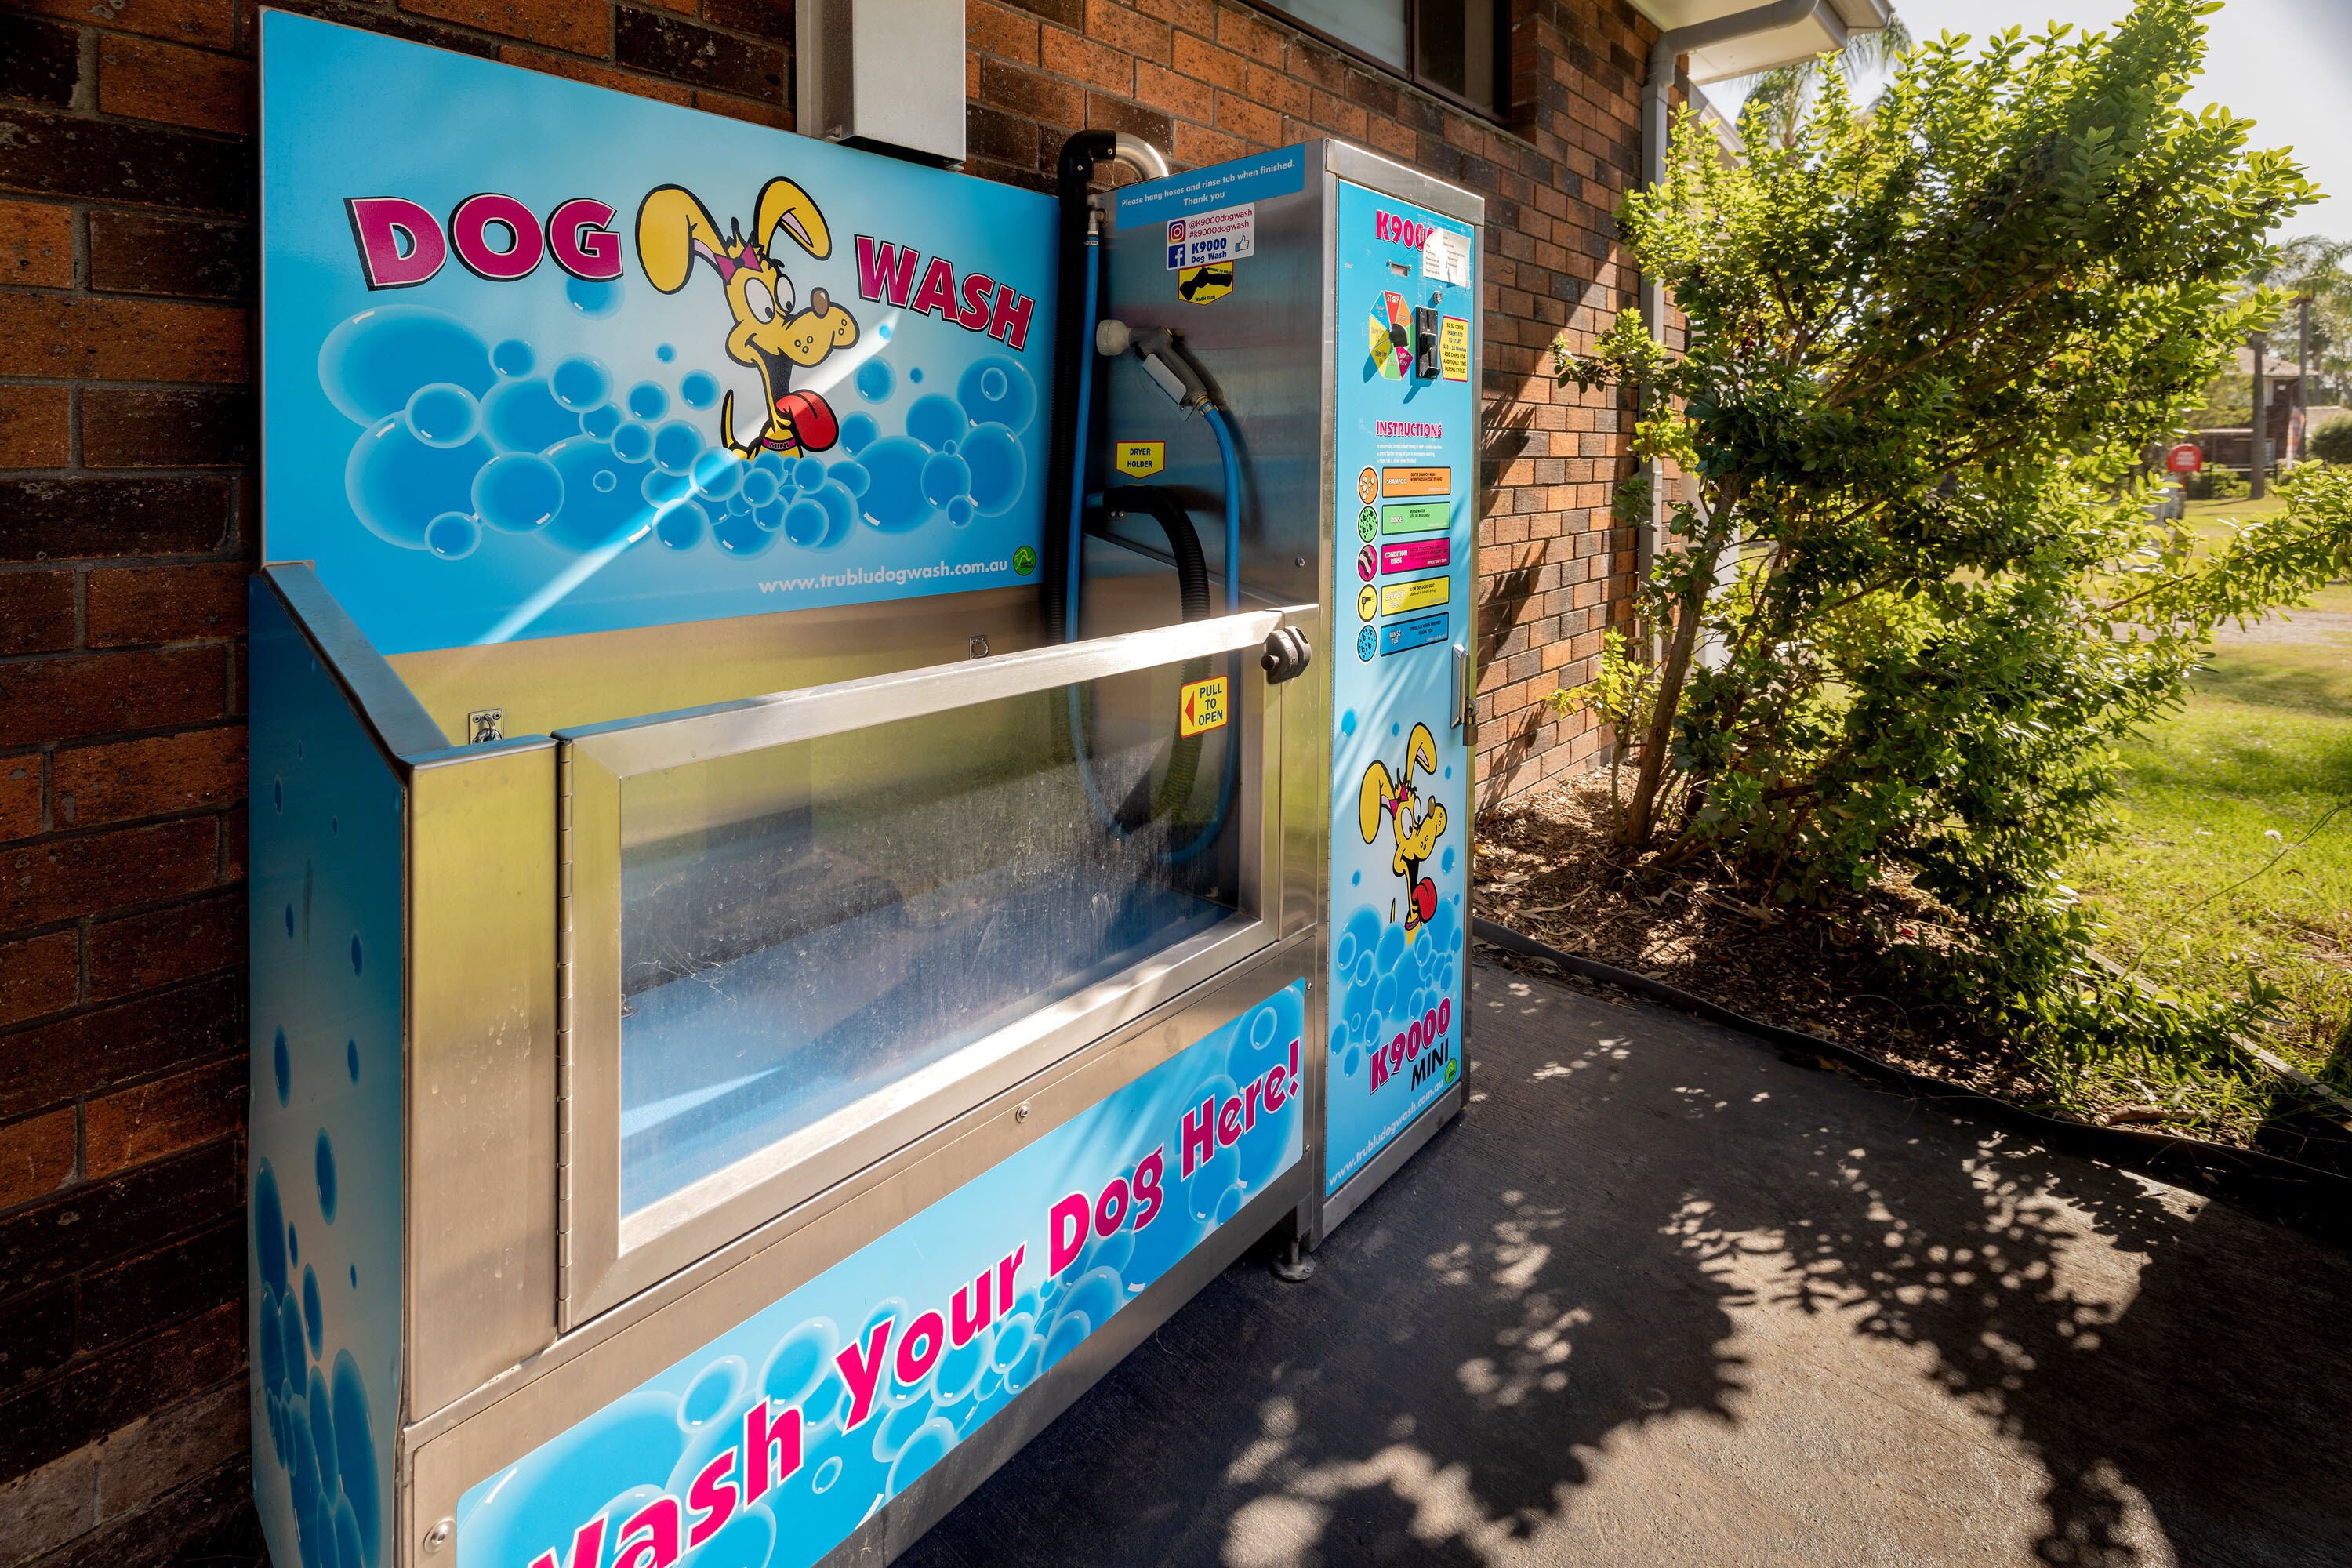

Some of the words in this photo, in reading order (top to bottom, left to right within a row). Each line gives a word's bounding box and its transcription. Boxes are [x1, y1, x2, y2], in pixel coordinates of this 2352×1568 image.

[1122, 197, 1143, 208] Please
[1145, 191, 1163, 201] hang
[1164, 187, 1185, 198] hoses
[1186, 182, 1200, 193] and
[1202, 178, 1221, 190] rinse
[1222, 174, 1236, 184] tub
[1237, 169, 1258, 180] when
[1260, 159, 1295, 174] finished.
[1183, 194, 1208, 206] Thank
[1210, 191, 1225, 202] you
[1189, 209, 1253, 229] @K9000dogwash
[1189, 220, 1250, 238] #k9000dogwash
[1192, 237, 1227, 255] K9000
[1208, 251, 1227, 260] Wash
[344, 194, 624, 291] DOG
[855, 234, 1036, 351] WASH
[1376, 420, 1442, 438] INSTRUCTIONS
[769, 441, 789, 450] MINI
[1129, 447, 1151, 456] DRYER
[1127, 459, 1152, 468] HOLDER
[1385, 550, 1408, 558] CONDITION
[759, 557, 1007, 594] www.trubludogwash.com.au
[1389, 630, 1401, 638] RINSE
[1199, 683, 1222, 698] PULL
[1204, 699, 1217, 710] TO
[1198, 710, 1223, 726] OPEN
[1370, 996, 1451, 1096] K9000
[1411, 1038, 1449, 1092] MINI
[1328, 1079, 1444, 1186] www.trubludogwash.com.au
[1047, 1141, 1165, 1279] Dog
[1180, 1039, 1301, 1183] Here!
